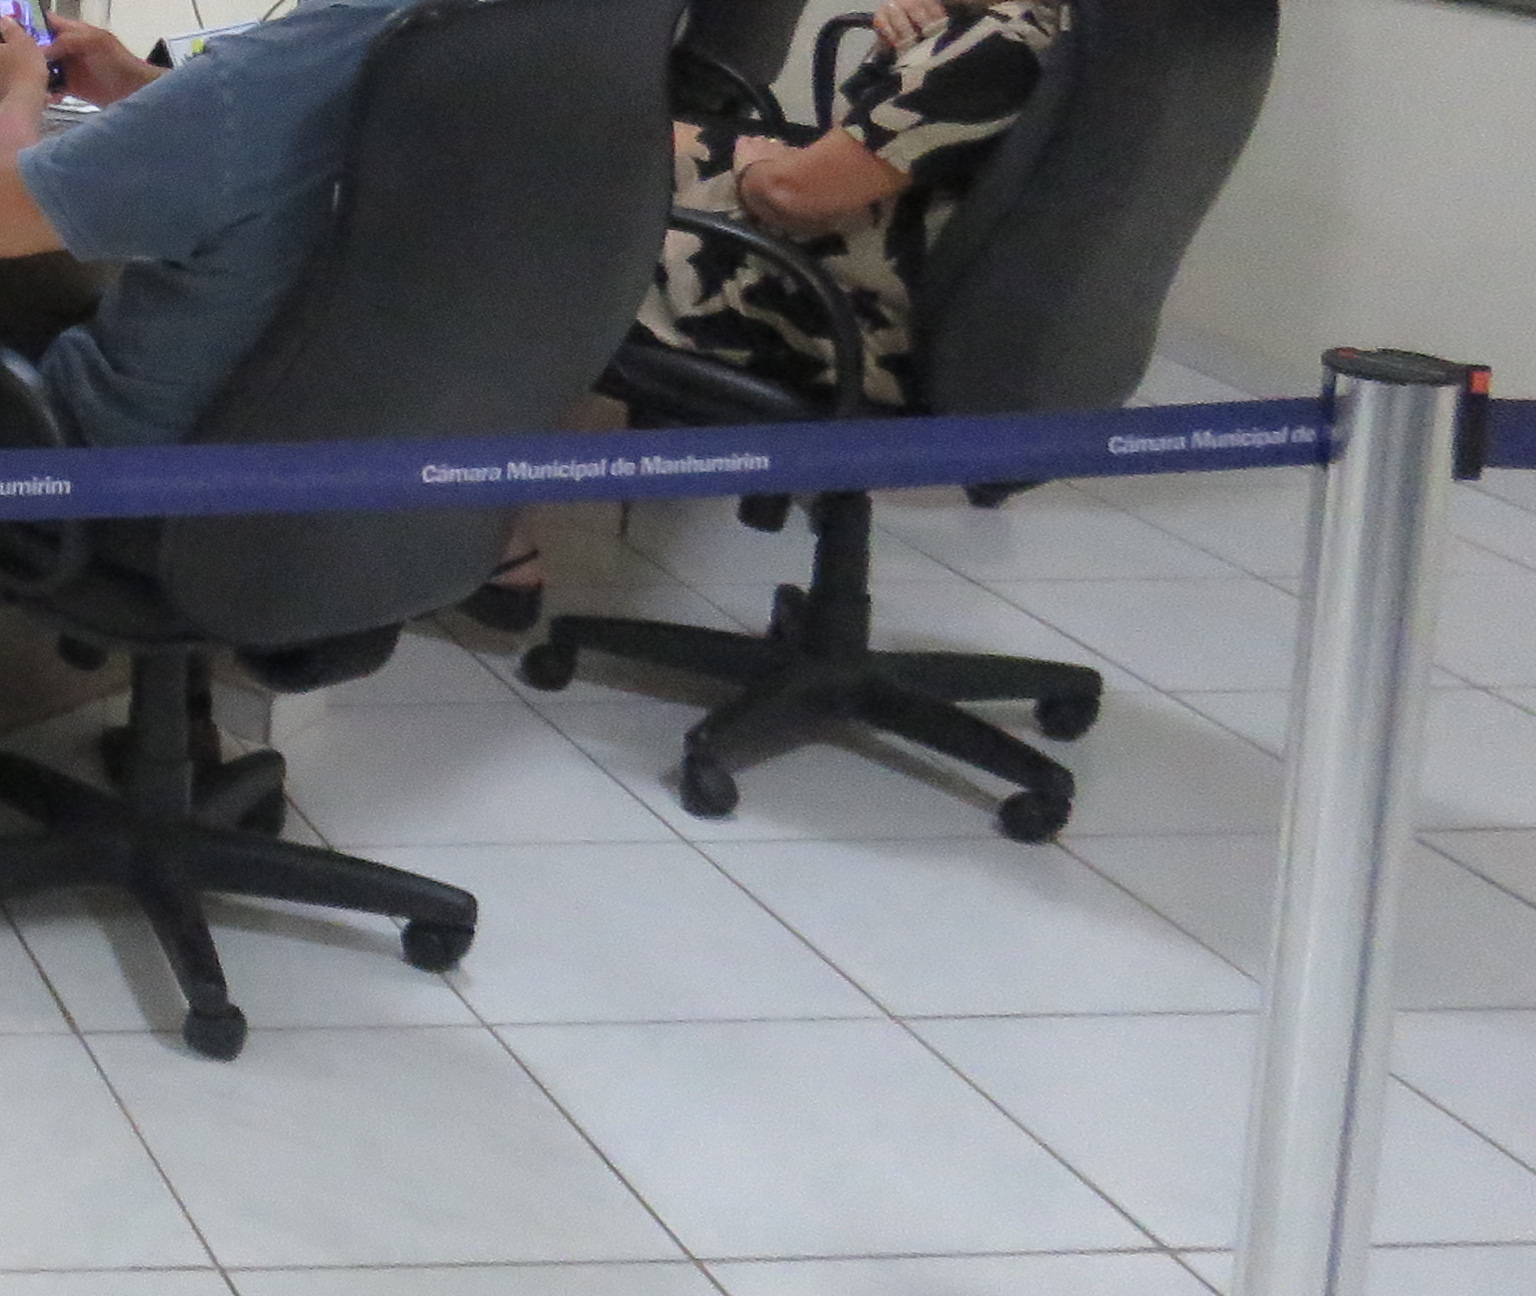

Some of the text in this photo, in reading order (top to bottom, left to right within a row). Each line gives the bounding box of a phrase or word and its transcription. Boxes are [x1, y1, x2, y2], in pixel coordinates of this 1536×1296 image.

[507, 458, 606, 481] Municipal
[610, 457, 636, 476] de
[640, 454, 770, 475] Manhumirim
